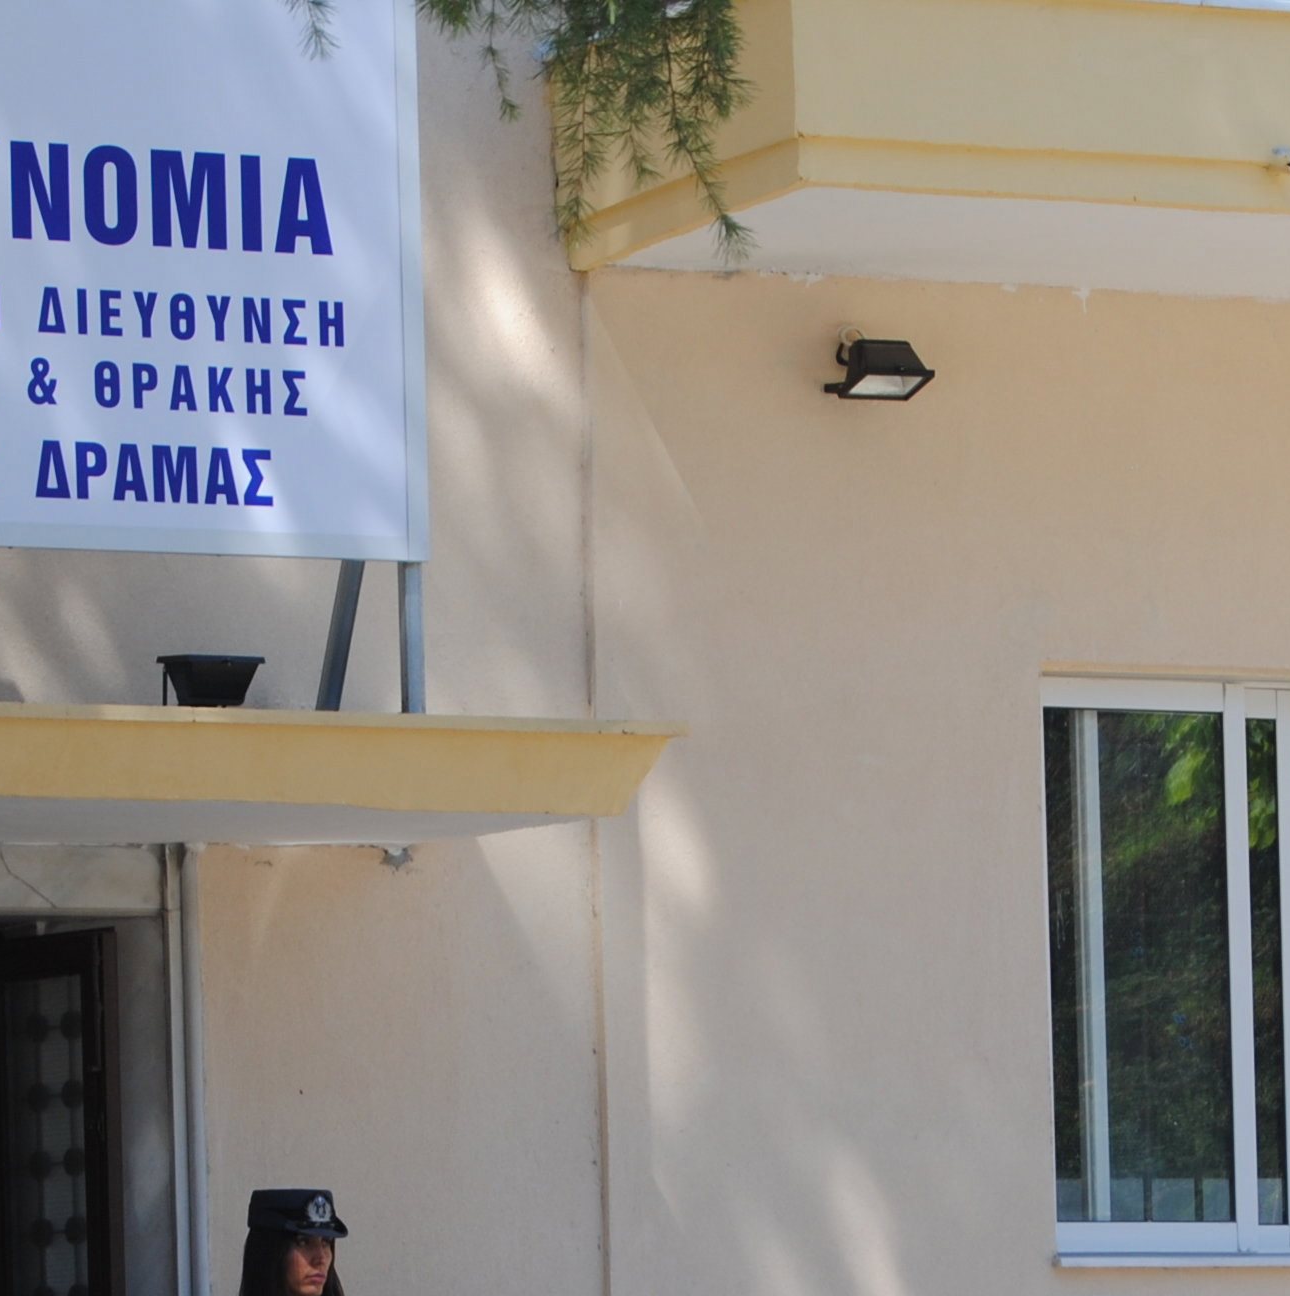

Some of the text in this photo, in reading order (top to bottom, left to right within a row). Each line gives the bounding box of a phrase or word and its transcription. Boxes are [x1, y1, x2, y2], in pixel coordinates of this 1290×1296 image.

[37, 286, 345, 347] ΔΙΕΥΘΥΝΣΗ
[26, 356, 58, 406] &
[93, 360, 308, 416] ΘΡΑΚΗΣ
[35, 439, 274, 507] ΔΡΑΜΑΣ
